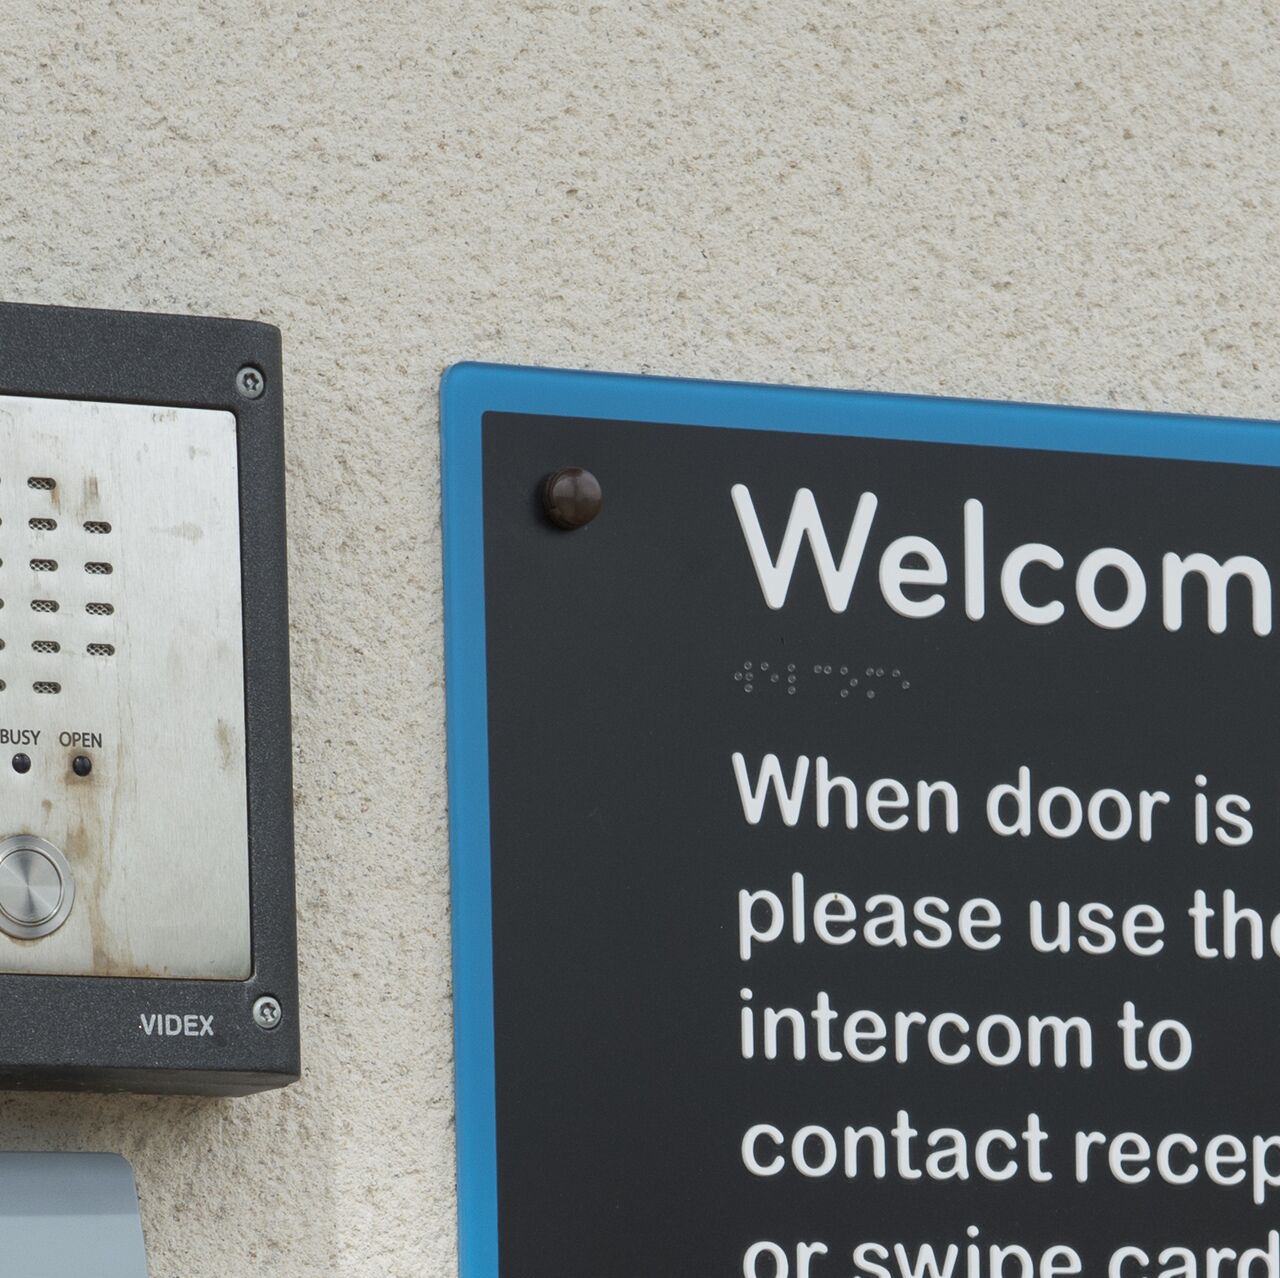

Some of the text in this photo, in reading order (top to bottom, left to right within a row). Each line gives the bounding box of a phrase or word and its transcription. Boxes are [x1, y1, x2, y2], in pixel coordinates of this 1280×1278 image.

[0, 728, 41, 746] BUSY
[59, 731, 102, 748] OPEN
[731, 751, 959, 834] When
[986, 765, 1171, 843] door
[1194, 773, 1254, 846] is
[738, 871, 1002, 961] please
[1029, 899, 1165, 957] use
[140, 1013, 214, 1037] VIDEX
[739, 987, 1193, 1071] intercom to
[741, 1109, 1053, 1183] contact
